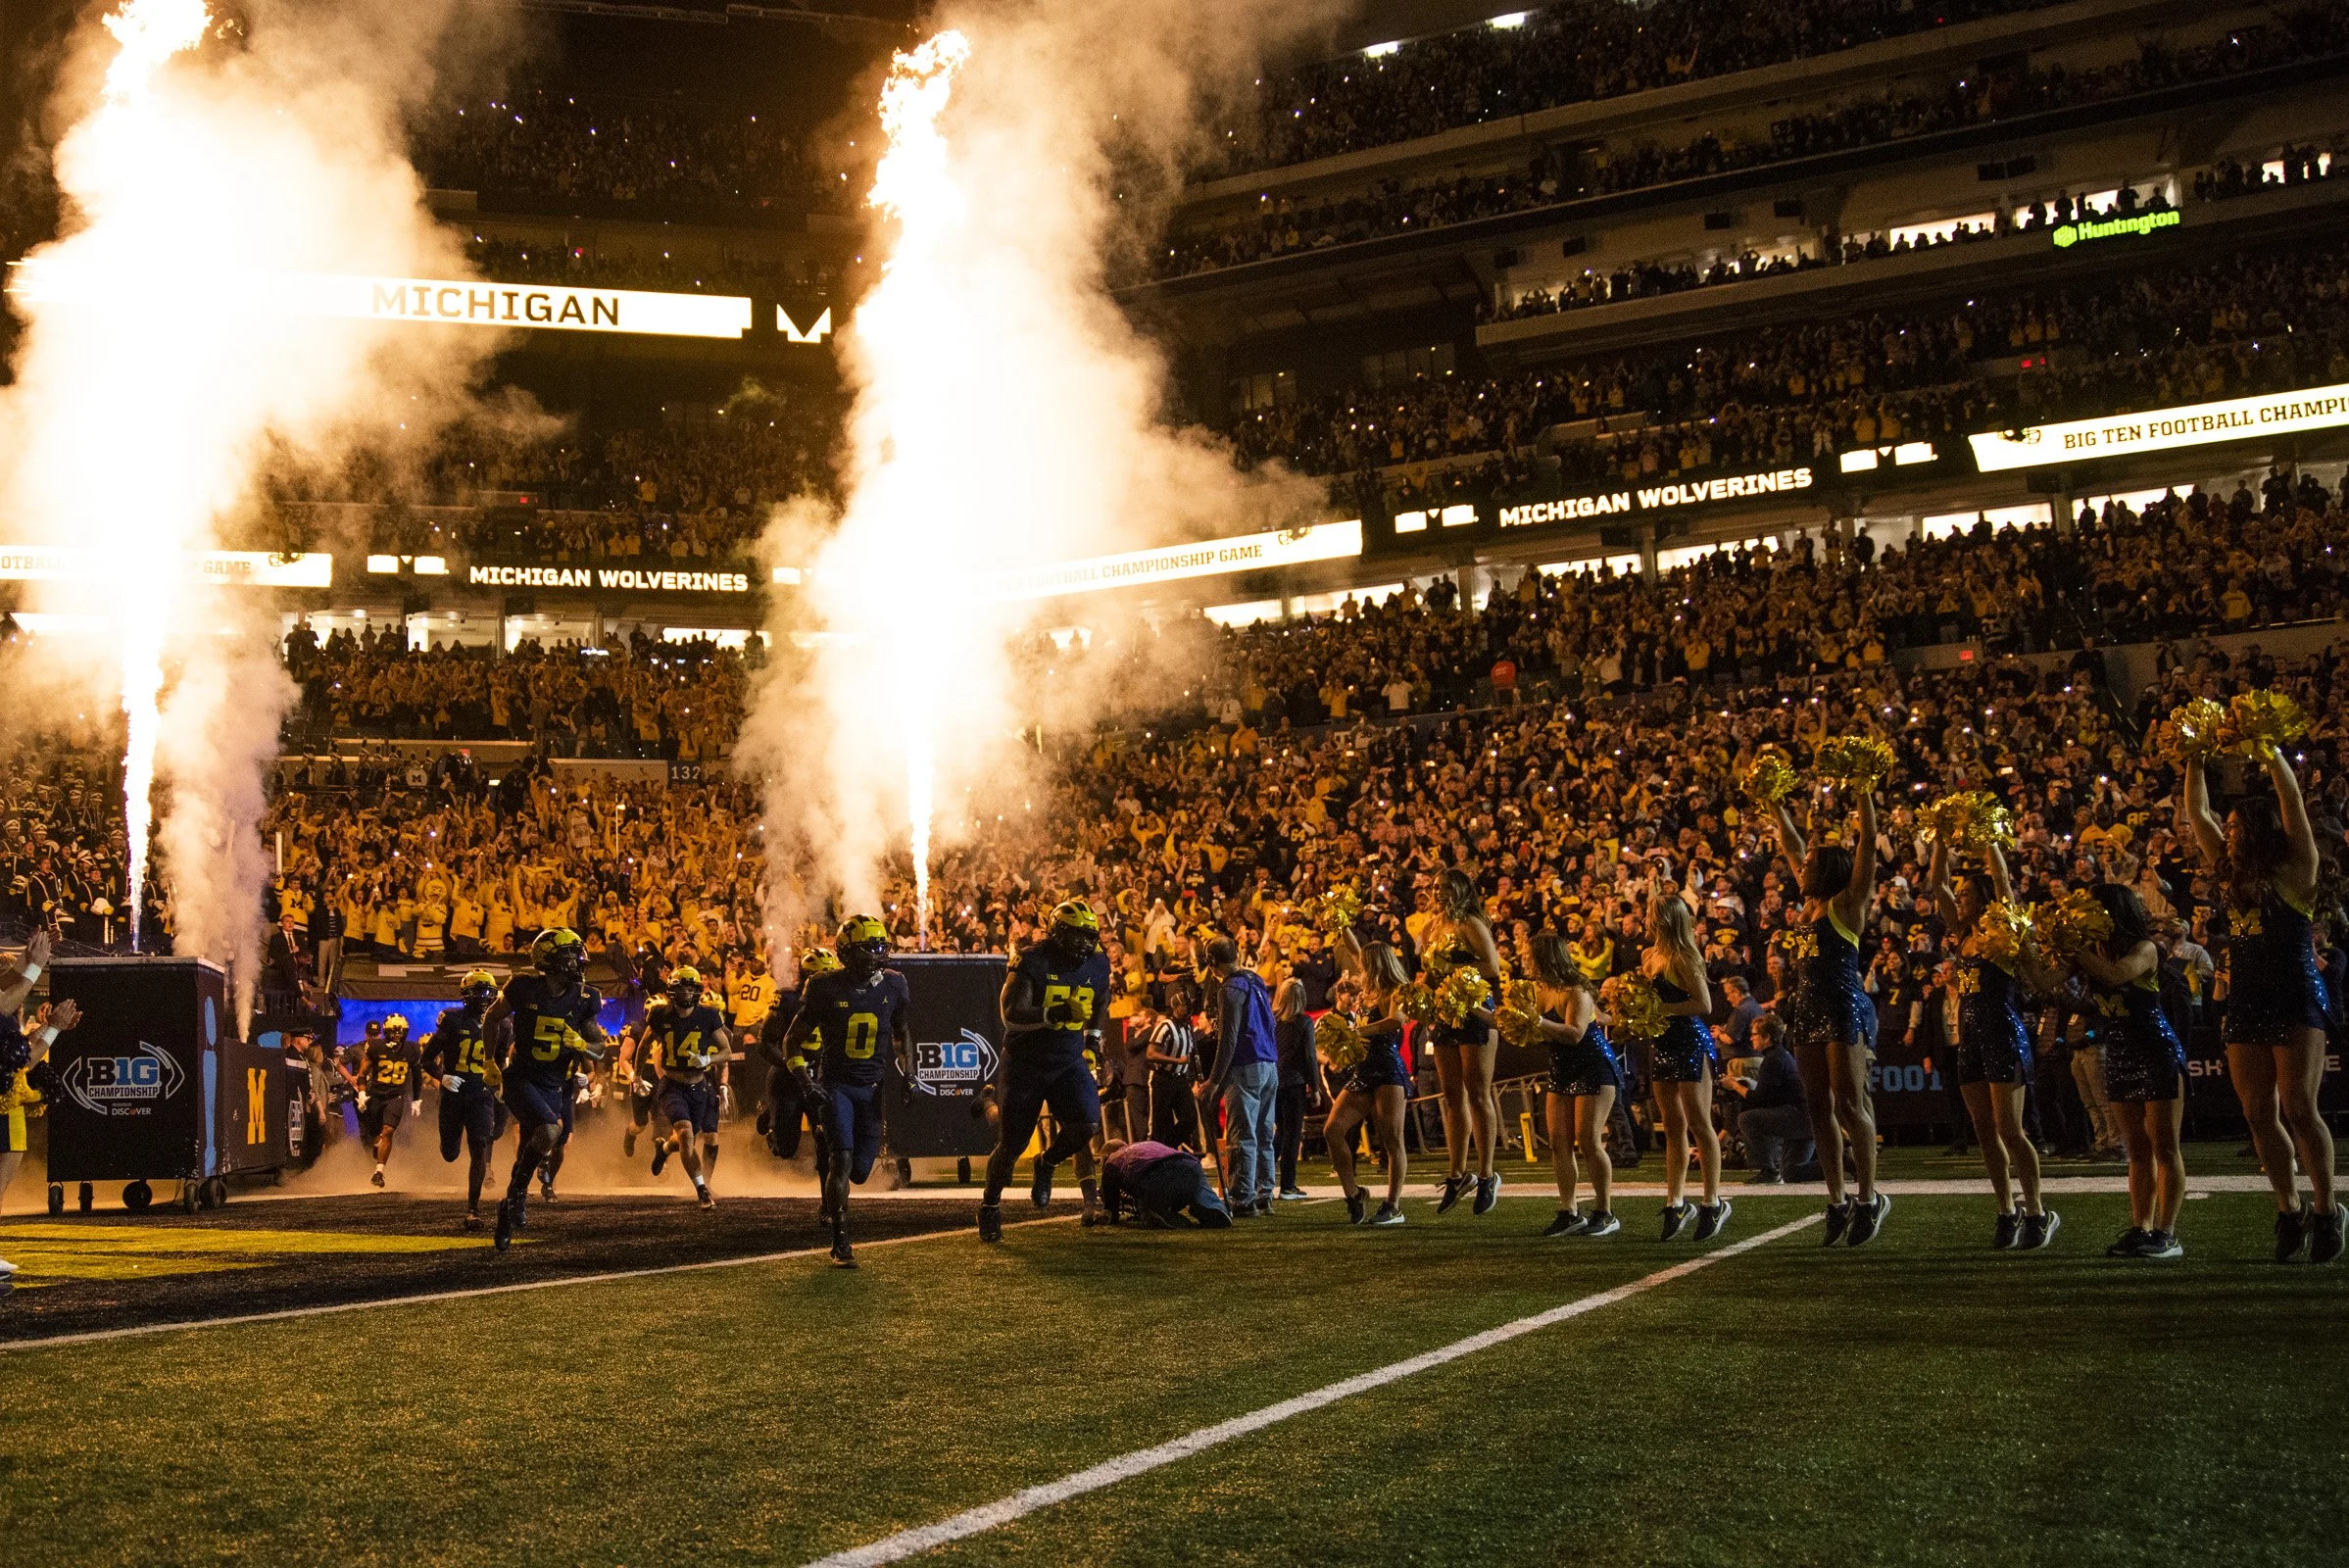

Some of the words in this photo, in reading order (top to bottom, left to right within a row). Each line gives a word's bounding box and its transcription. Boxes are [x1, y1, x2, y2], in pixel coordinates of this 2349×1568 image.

[2078, 211, 2180, 241] Huntington
[371, 281, 619, 326] MICHIGAN
[2063, 430, 2097, 450] BIG
[2102, 424, 2142, 444] TEN
[2148, 411, 2254, 438] FOOTBALL
[2259, 396, 2349, 423] CHAMPI
[1499, 491, 1631, 528] MICHIGAN
[1637, 467, 1813, 509] WOLVERINES
[203, 560, 251, 575] GAME
[1102, 550, 1215, 580] CHAMPIONSHIP
[1219, 544, 1263, 564] GAME
[469, 565, 592, 587] MICHIGAN
[598, 569, 749, 592] WOLVERINES
[671, 765, 701, 780] 132
[1290, 828, 1306, 842] 64
[290, 898, 304, 910] M
[2227, 907, 2264, 936] M
[740, 984, 760, 1002] 20
[1957, 967, 1981, 994] M
[1887, 988, 1901, 1005] 7
[2093, 993, 2130, 1017] M
[531, 1014, 565, 1061] 5
[663, 1030, 703, 1068] 14
[845, 1012, 878, 1059] 0
[377, 1059, 409, 1085] 28
[919, 1069, 979, 1079] CHAMPIONSHIP
[88, 1086, 159, 1098] CHAMPIONSHIP
